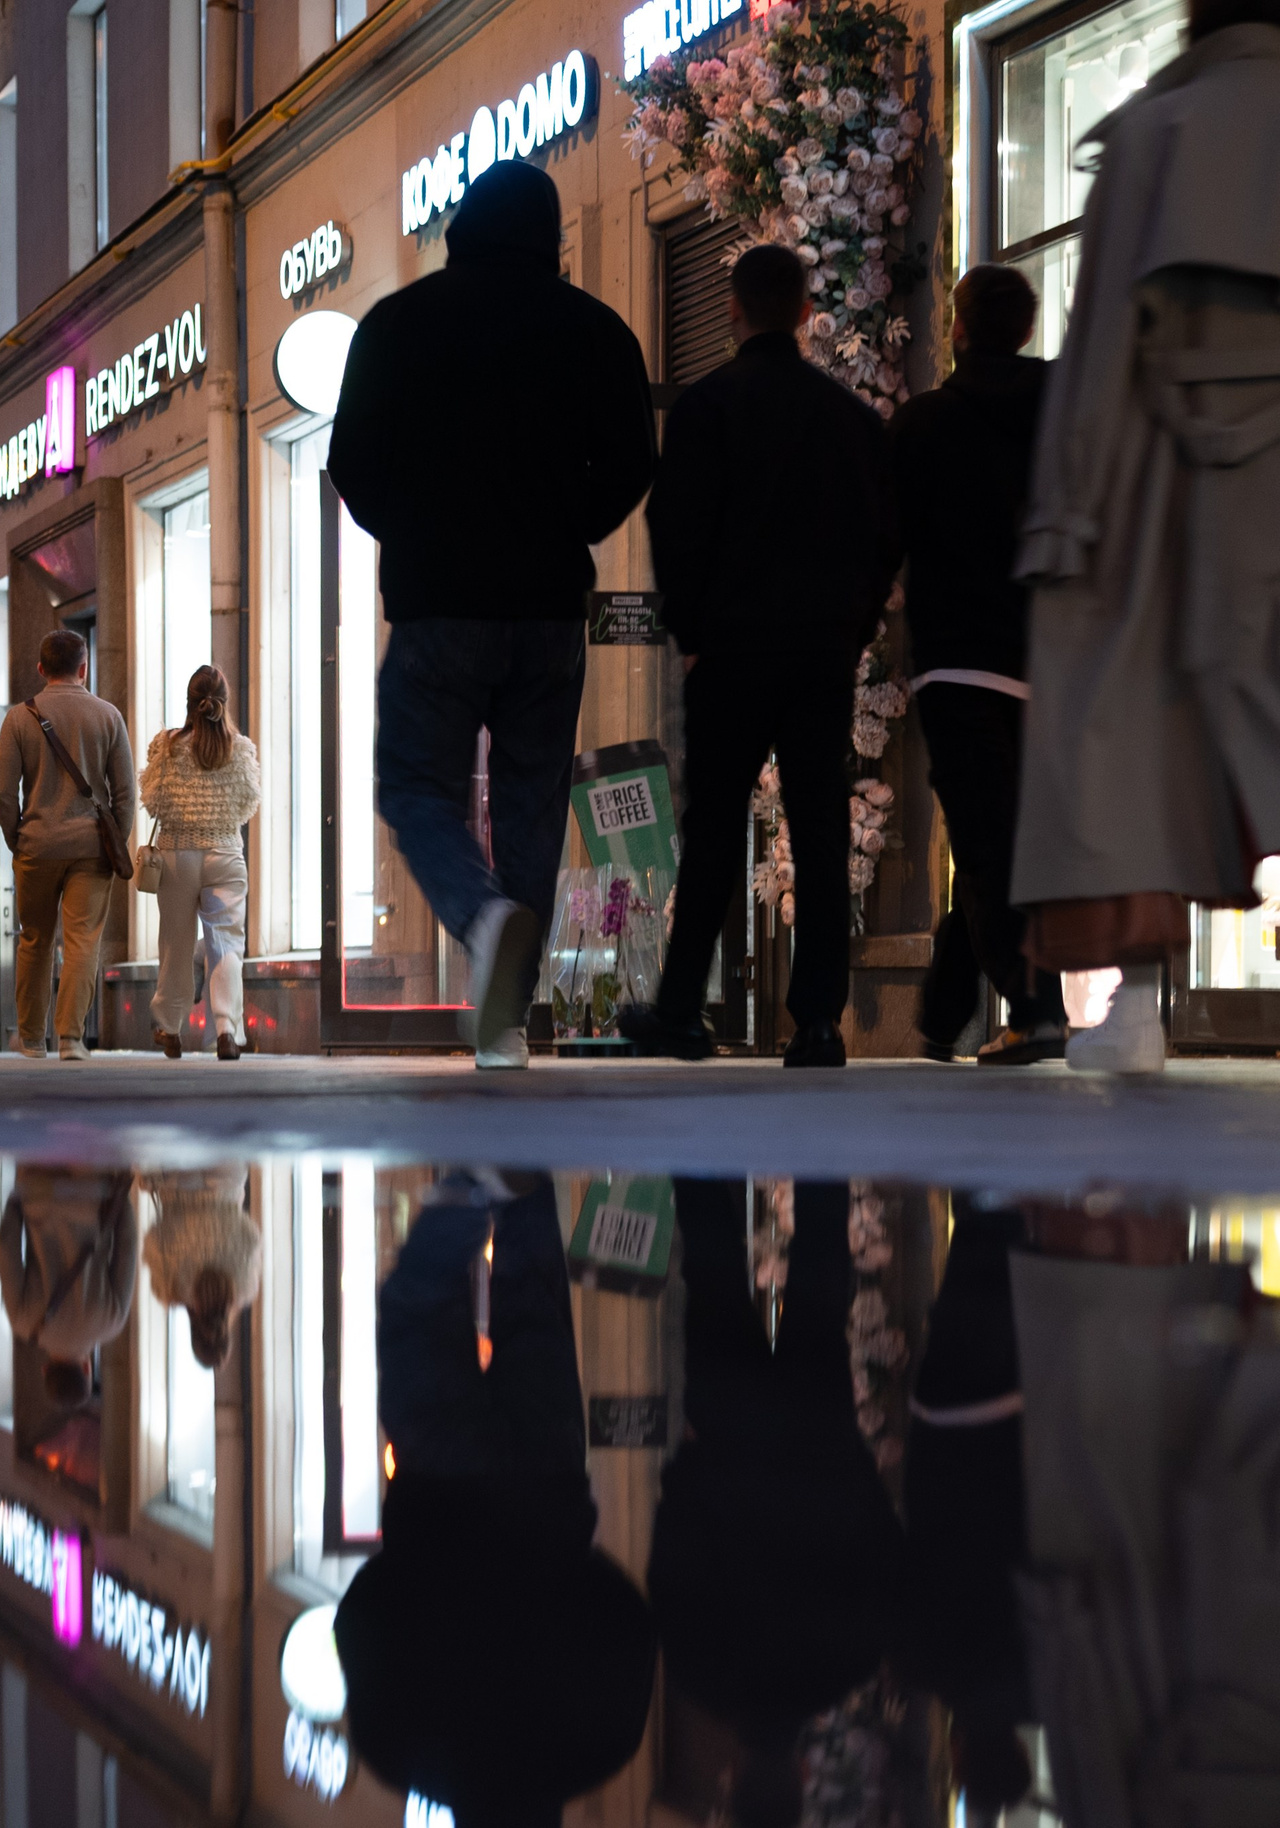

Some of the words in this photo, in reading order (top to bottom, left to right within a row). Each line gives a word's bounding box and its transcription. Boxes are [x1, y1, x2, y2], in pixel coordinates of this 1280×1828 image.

[402, 132, 465, 236] КОФЕ
[497, 49, 586, 161] DOMO
[280, 219, 342, 300] ОБУВЬ
[600, 801, 651, 829] COFFEE
[603, 782, 646, 808] PRICE
